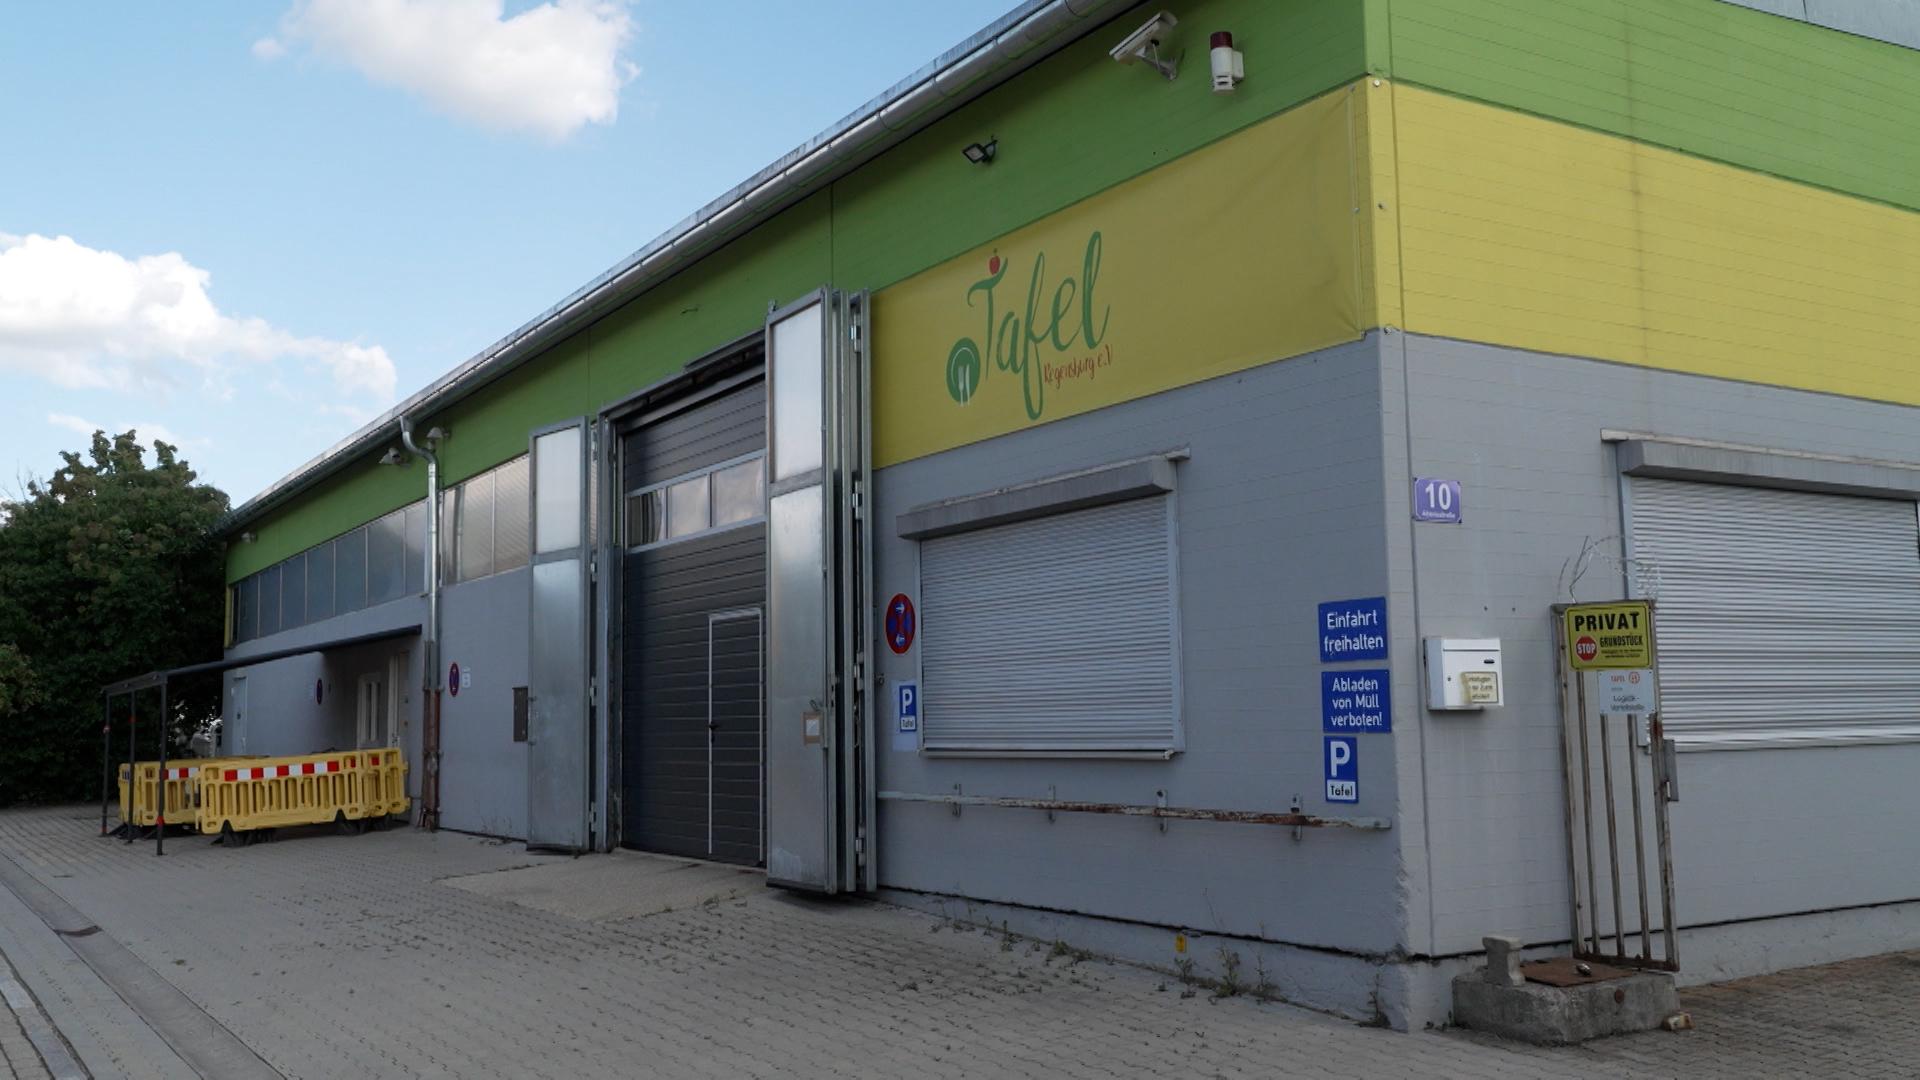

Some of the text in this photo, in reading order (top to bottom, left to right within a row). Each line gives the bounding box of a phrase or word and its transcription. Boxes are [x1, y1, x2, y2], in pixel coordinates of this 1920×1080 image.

[967, 231, 1110, 420] Tafel
[1425, 483, 1451, 510] 10
[1327, 610, 1377, 630] Einfahrt
[1574, 612, 1640, 632] PRIVAT
[1324, 635, 1384, 653] freihalten
[1577, 643, 1596, 654] STOP
[1332, 677, 1378, 692] Abladen
[902, 688, 913, 714] P
[1332, 694, 1379, 709] von Müll
[1331, 712, 1383, 727] verboten!
[1330, 741, 1350, 777] P
[1330, 785, 1353, 797] Tafel
